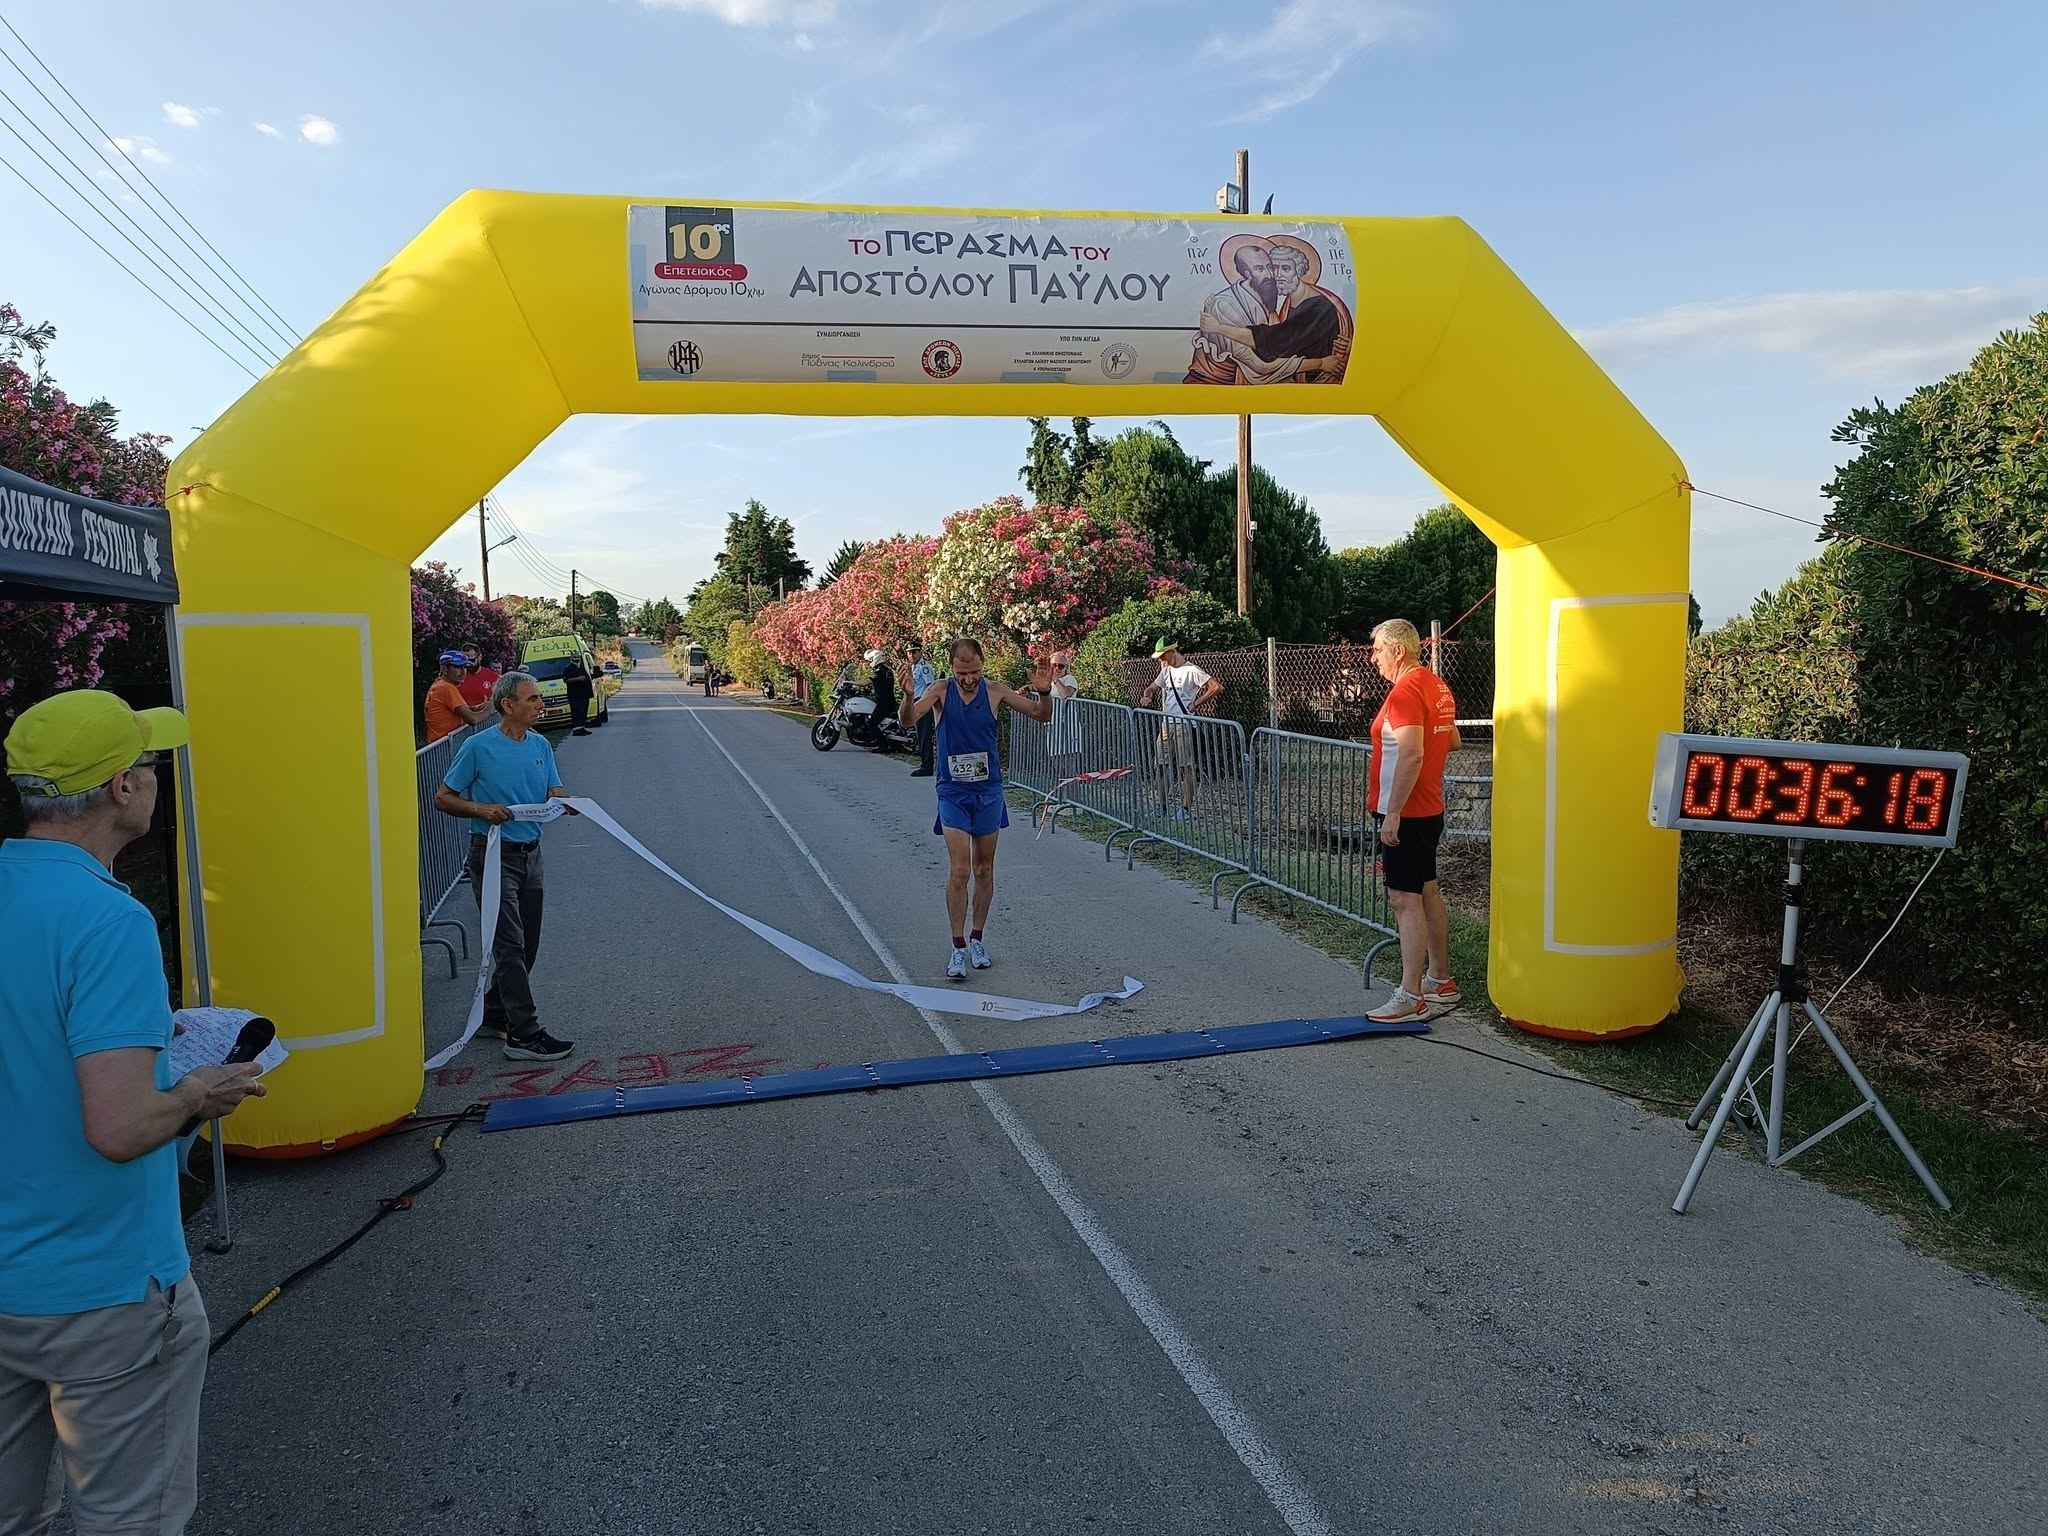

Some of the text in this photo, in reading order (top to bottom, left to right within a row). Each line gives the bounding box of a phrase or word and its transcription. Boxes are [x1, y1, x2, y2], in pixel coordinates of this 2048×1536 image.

[848, 238, 881, 255] ΤΟ
[1070, 246, 1111, 262] ΤΟΥ
[663, 264, 732, 278] Επετειακός
[639, 284, 681, 297] Αγώνας
[683, 284, 728, 298] Δρόμου
[801, 359, 840, 369] Πύδνας
[81, 507, 143, 577] FESTIVAL
[953, 763, 973, 774] 432
[1680, 754, 1946, 831] 00:36:18
